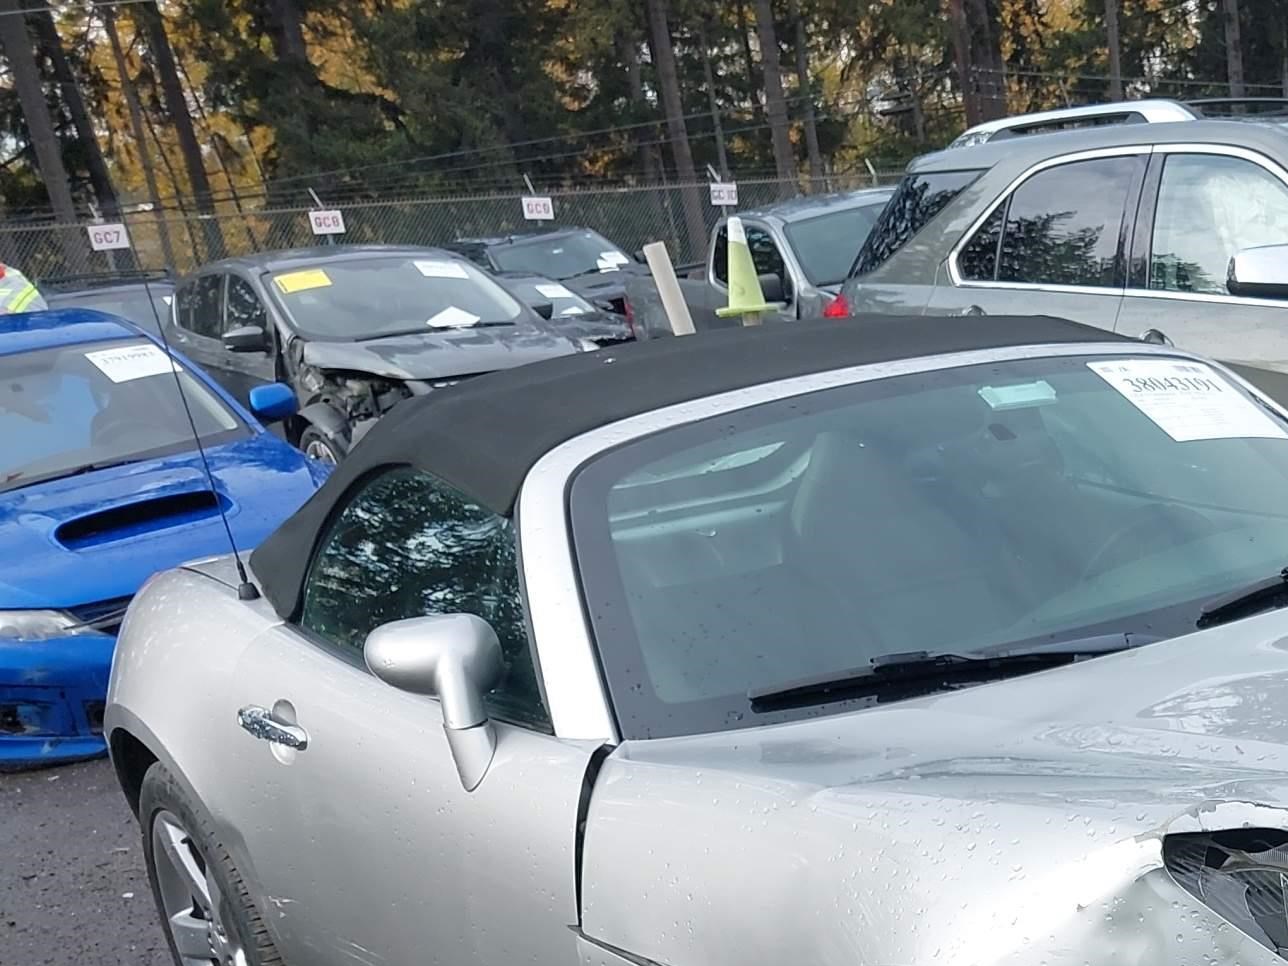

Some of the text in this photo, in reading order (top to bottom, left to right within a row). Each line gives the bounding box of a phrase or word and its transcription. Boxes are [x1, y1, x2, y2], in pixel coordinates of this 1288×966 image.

[314, 216, 340, 228] GC8
[94, 231, 120, 244] GC7
[1123, 376, 1223, 393] 38043191
